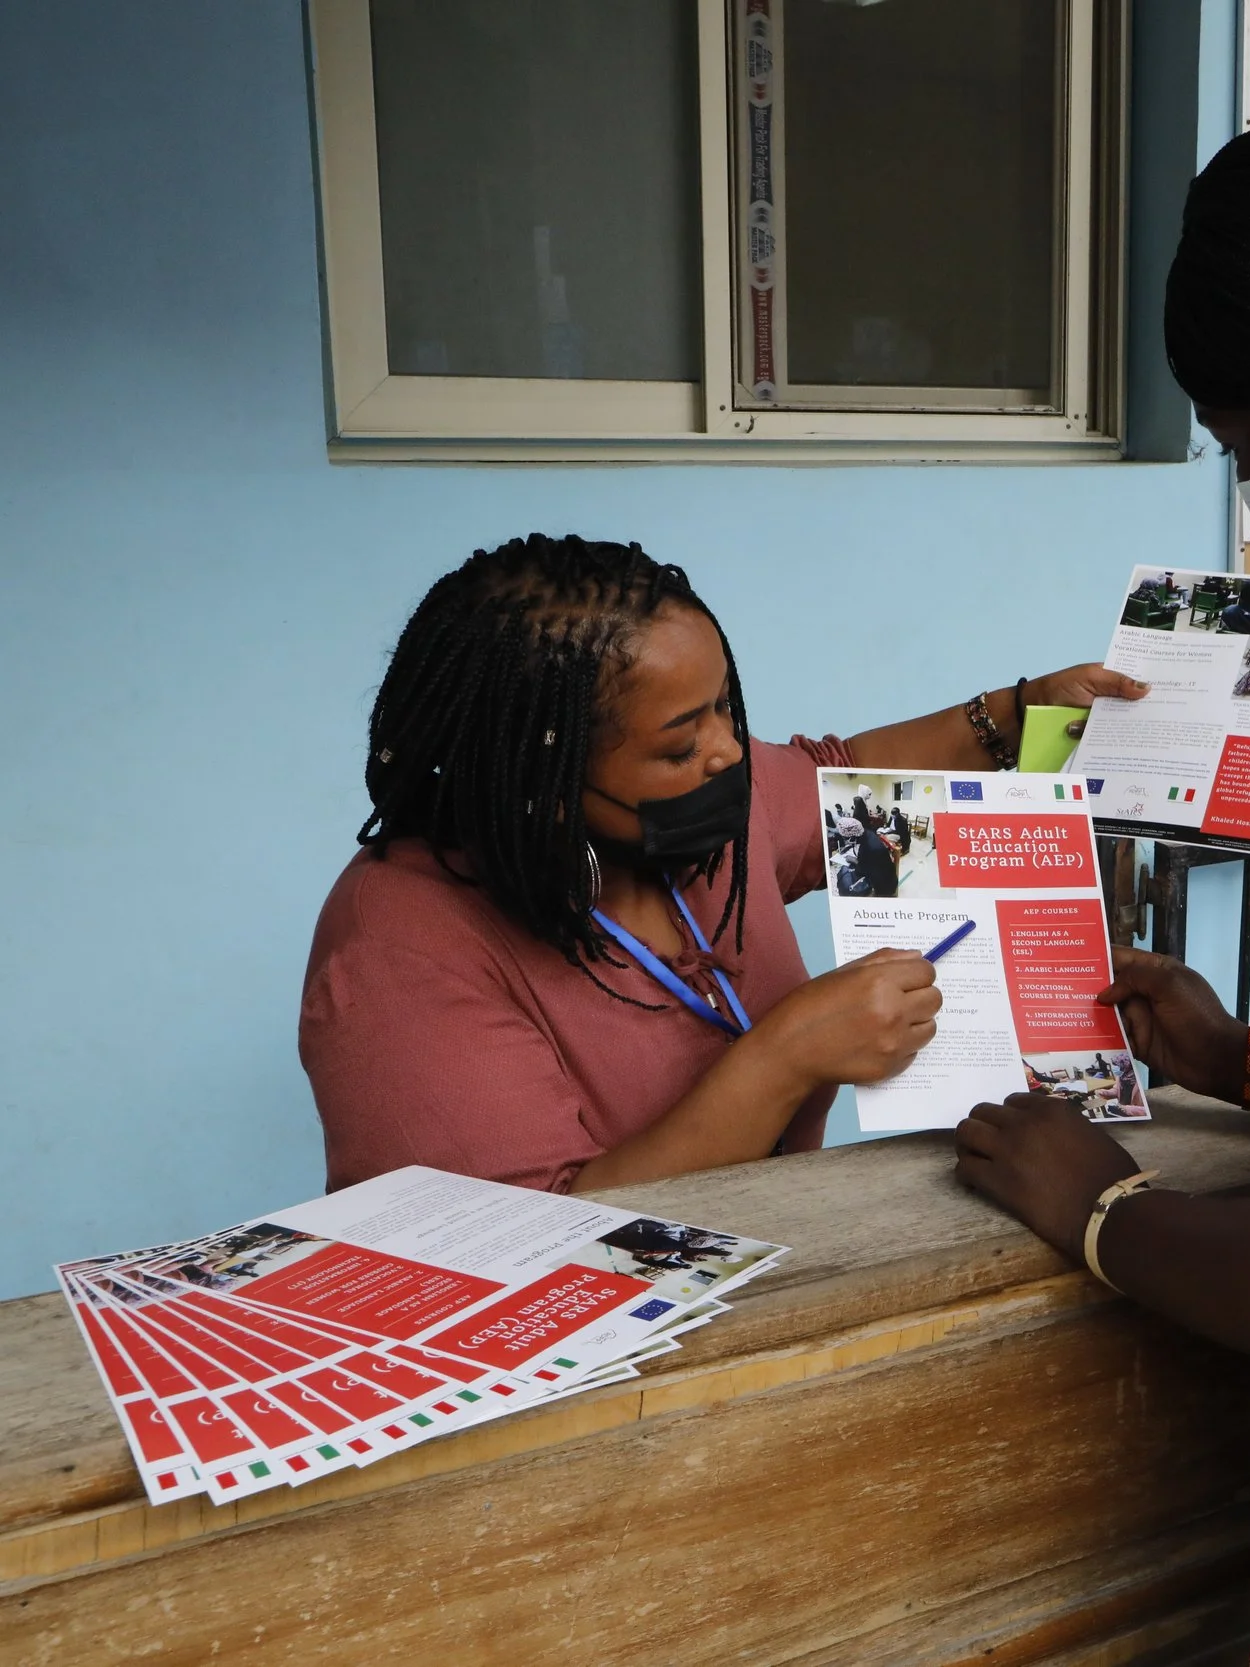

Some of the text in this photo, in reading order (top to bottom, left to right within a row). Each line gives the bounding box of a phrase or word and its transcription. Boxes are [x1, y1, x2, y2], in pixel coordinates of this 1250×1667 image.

[958, 826, 1068, 839] StARS Adult
[1211, 816, 1234, 824] Khaled
[970, 840, 1059, 853] Education
[948, 852, 1084, 870] Program (AEP)
[853, 910, 969, 923] About the Program
[1012, 948, 1033, 956] (ESL)
[512, 1216, 614, 1269] About the Program
[302, 1262, 361, 1291] INFORMATION
[307, 1255, 362, 1281] TECHNOLOGY
[305, 1262, 394, 1305] COURSES FOR WOMEN
[385, 1275, 414, 1290] ARABIC
[337, 1288, 384, 1313] LANGUAGE
[374, 1277, 453, 1317] SECOND LANGUAGE
[409, 1299, 421, 1308] AS
[414, 1294, 471, 1325] AEP COURSES
[458, 1273, 598, 1349] Program (AEP)
[498, 1289, 594, 1340] Education
[504, 1288, 617, 1351] StARS Adult
